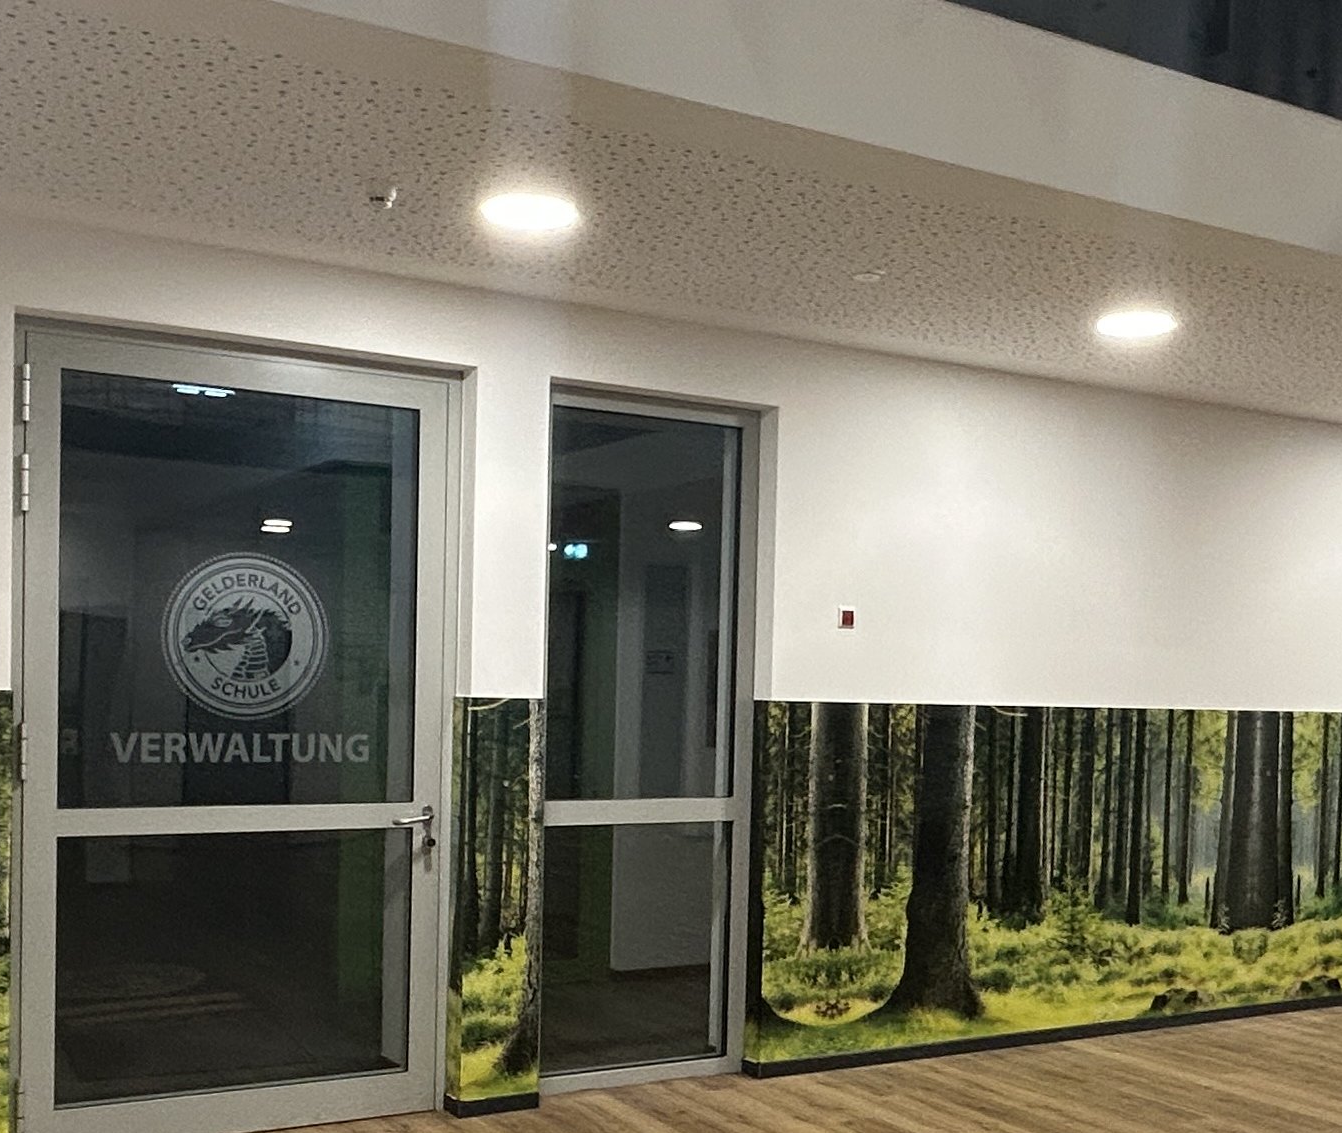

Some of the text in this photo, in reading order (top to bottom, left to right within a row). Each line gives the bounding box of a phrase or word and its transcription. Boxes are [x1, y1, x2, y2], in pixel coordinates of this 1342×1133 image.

[194, 574, 301, 616] GELDERLAND
[211, 677, 281, 699] SCHULE
[110, 731, 370, 763] VERWALTUNG
